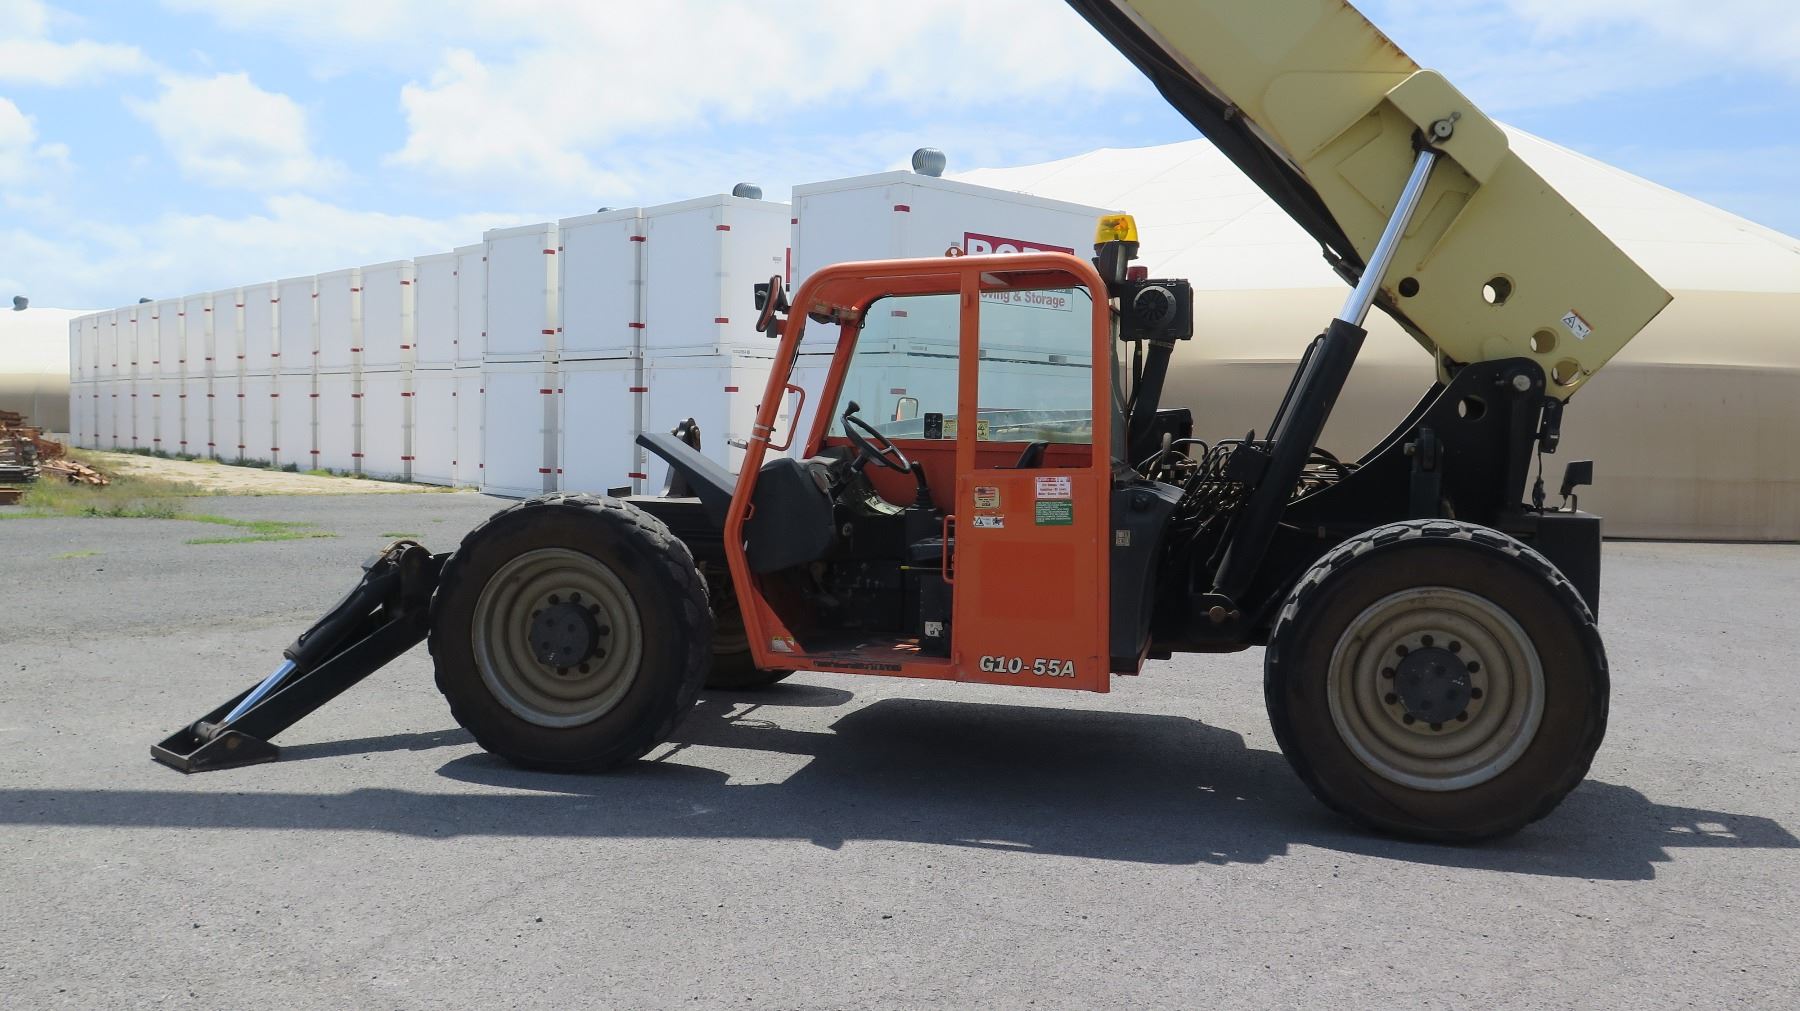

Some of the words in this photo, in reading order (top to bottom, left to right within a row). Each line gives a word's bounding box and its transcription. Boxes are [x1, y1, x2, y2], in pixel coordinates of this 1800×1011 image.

[981, 291, 1009, 303] oving
[1013, 291, 1021, 302] &
[1025, 292, 1065, 308] Storage
[979, 655, 1075, 678] G10-55A
